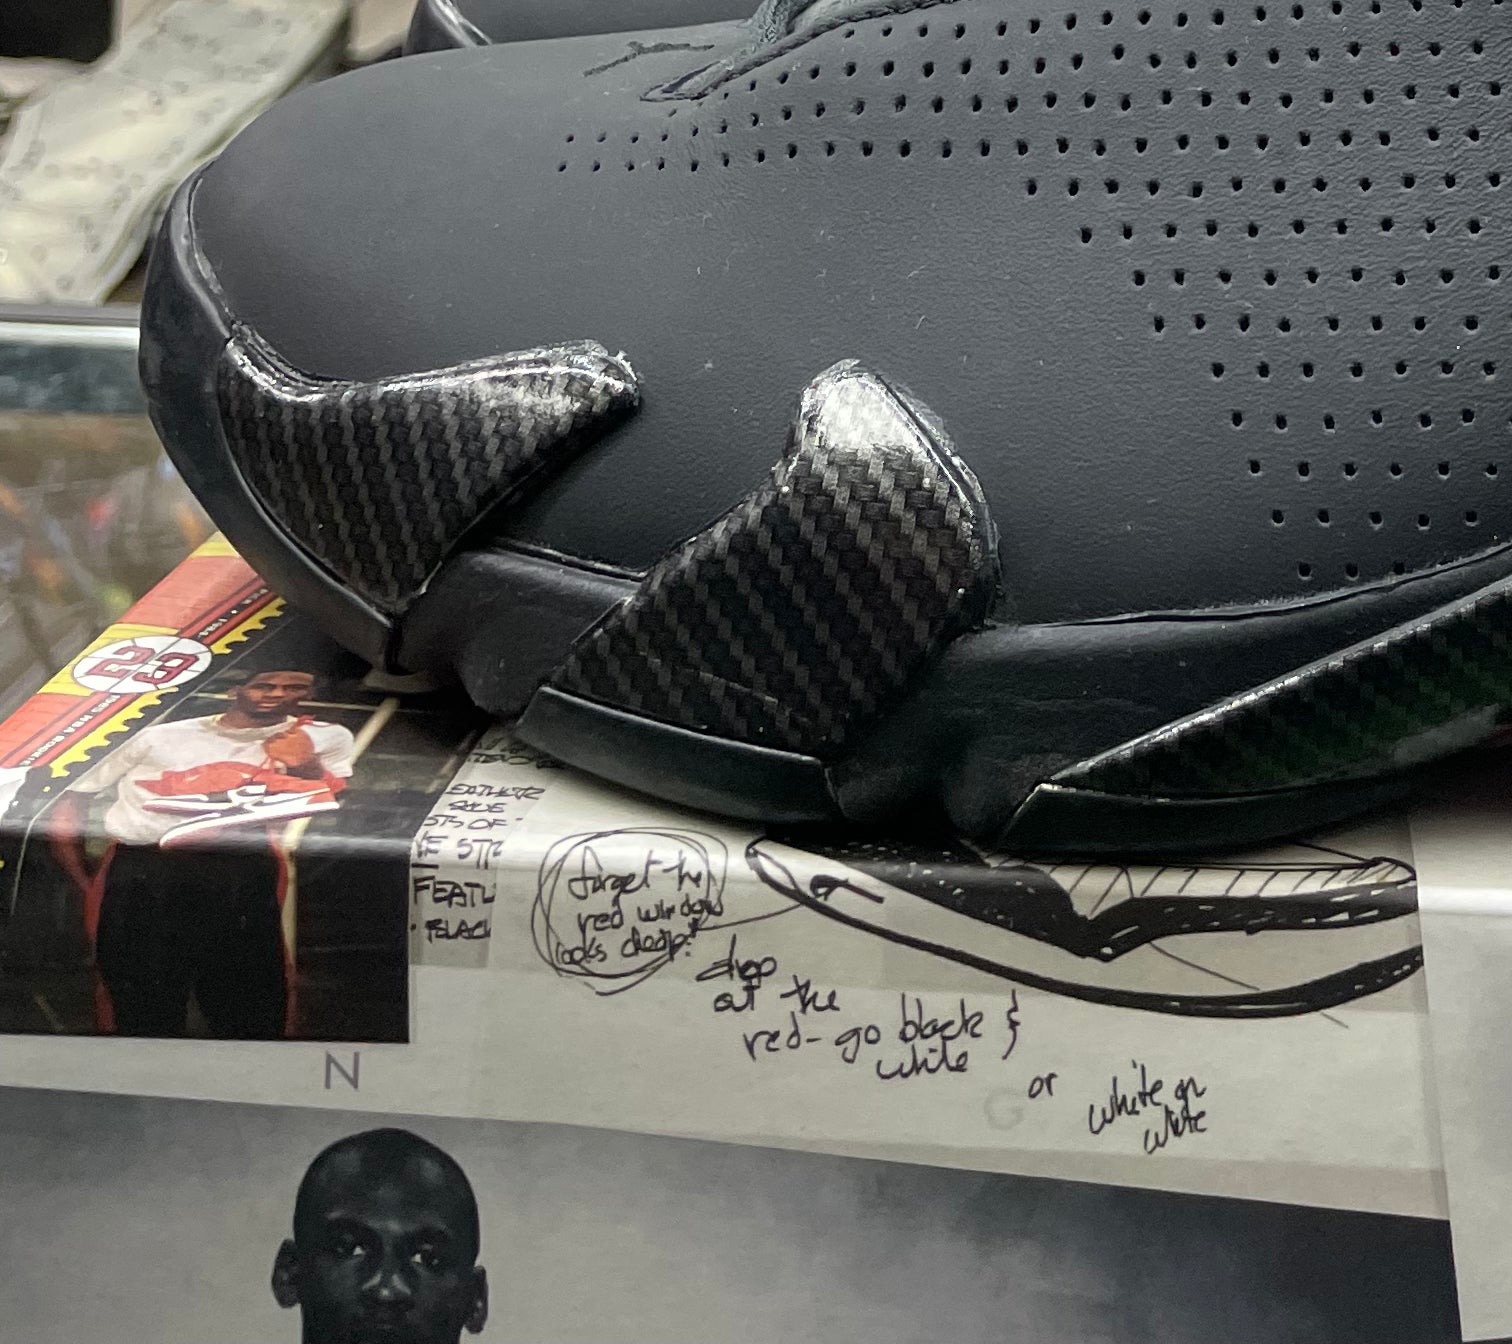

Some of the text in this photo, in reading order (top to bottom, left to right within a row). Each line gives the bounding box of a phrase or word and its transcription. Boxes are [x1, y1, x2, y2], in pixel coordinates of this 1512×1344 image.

[85, 645, 200, 685] 23
[63, 715, 93, 733] NBA
[780, 974, 840, 1014] the
[834, 1024, 881, 1063] go
[899, 992, 984, 1045] black
[325, 1051, 360, 1090] N
[876, 1043, 968, 1080] white
[1028, 1072, 1058, 1099] or
[1089, 1059, 1163, 1135] white
